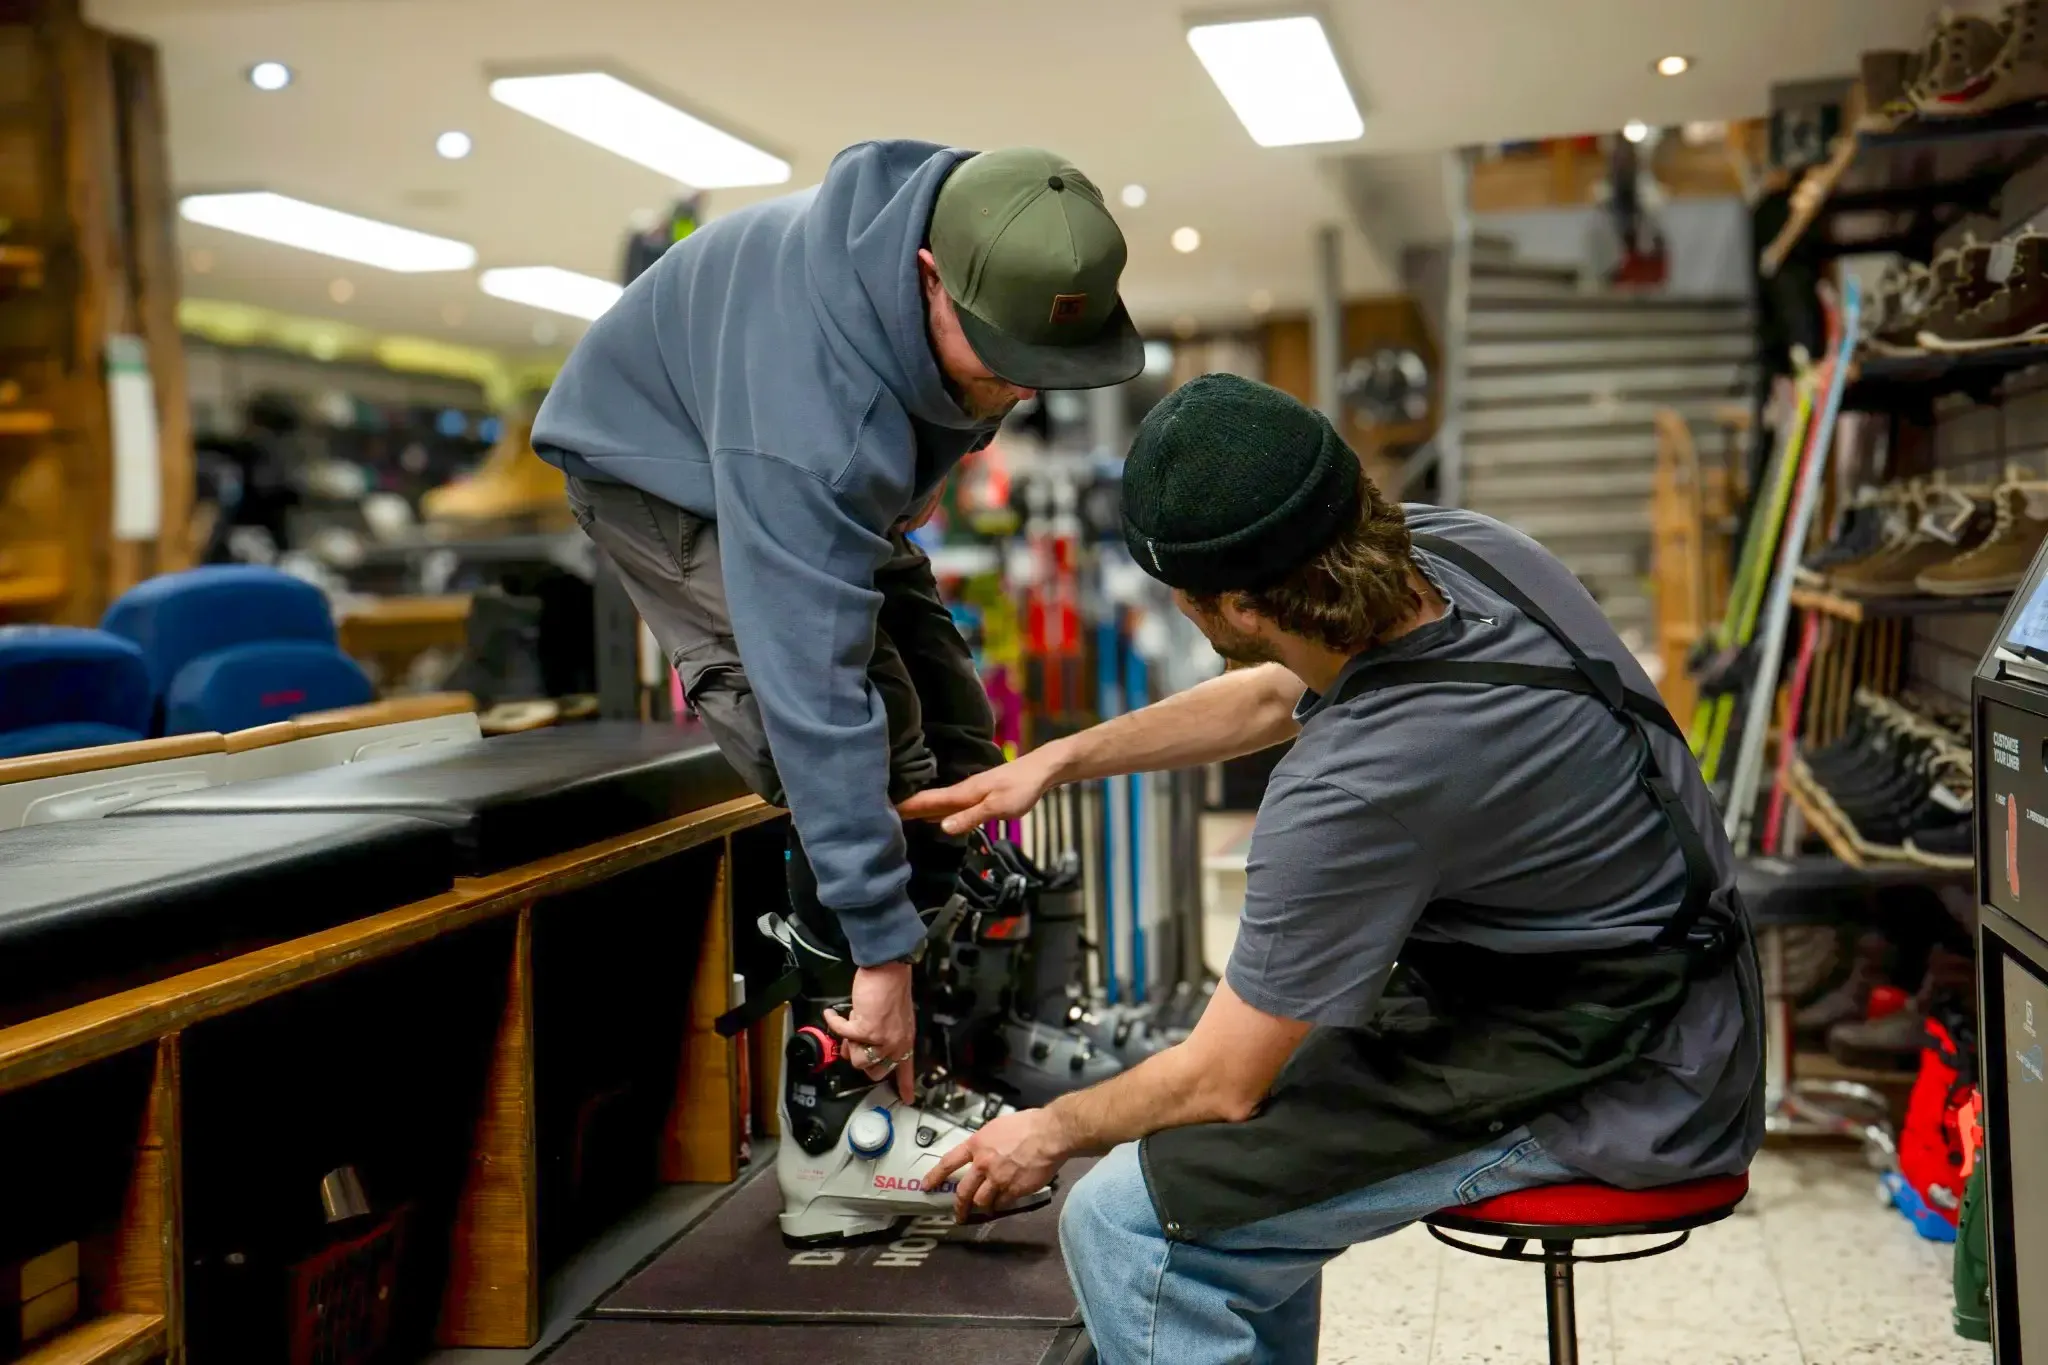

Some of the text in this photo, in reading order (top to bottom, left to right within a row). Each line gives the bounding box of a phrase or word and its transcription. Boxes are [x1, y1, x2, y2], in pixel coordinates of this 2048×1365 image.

[1993, 731, 2019, 754] CUSTOMIZE
[1993, 747, 2020, 772] YOUR LINER
